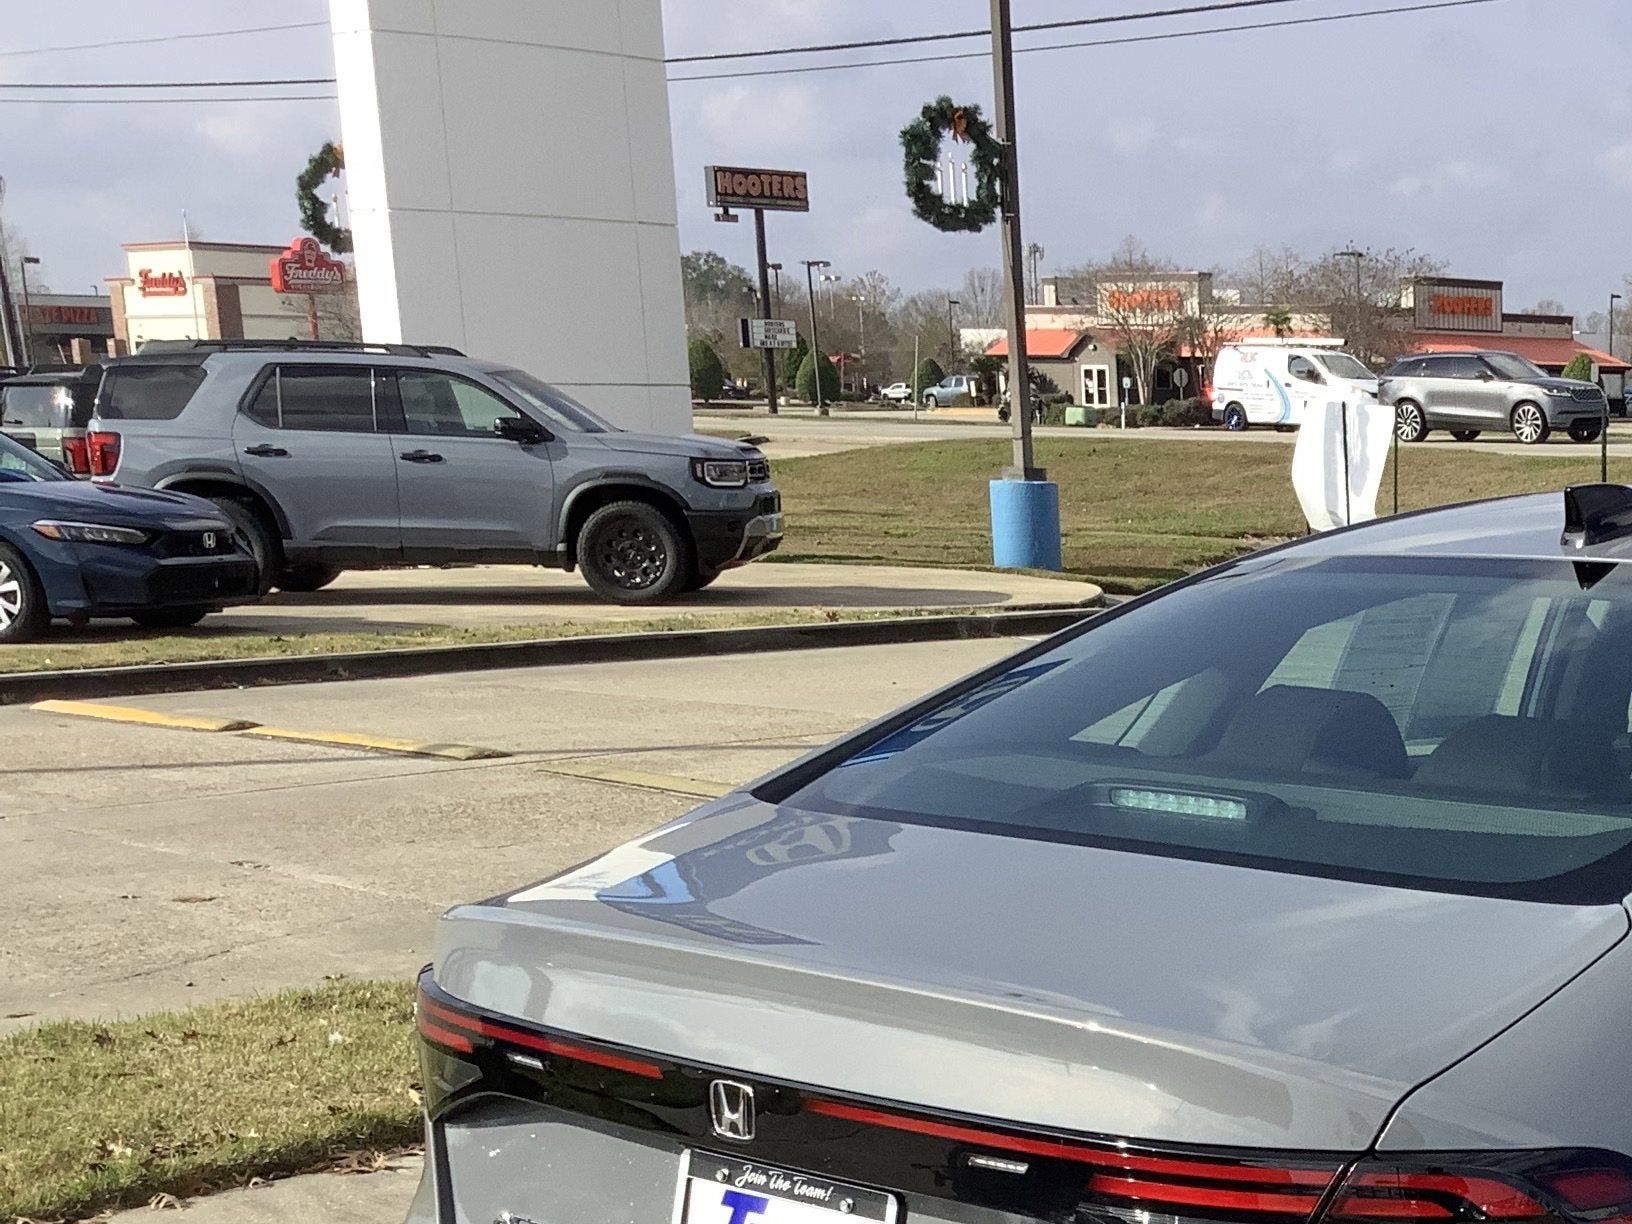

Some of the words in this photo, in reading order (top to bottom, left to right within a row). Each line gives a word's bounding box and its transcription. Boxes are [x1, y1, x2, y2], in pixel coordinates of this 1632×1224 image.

[717, 171, 806, 198] HOOTERS
[284, 263, 342, 281] Freddy's
[735, 1164, 768, 1188] Join
[768, 1169, 792, 1192] The
[793, 1176, 834, 1201] Team!
